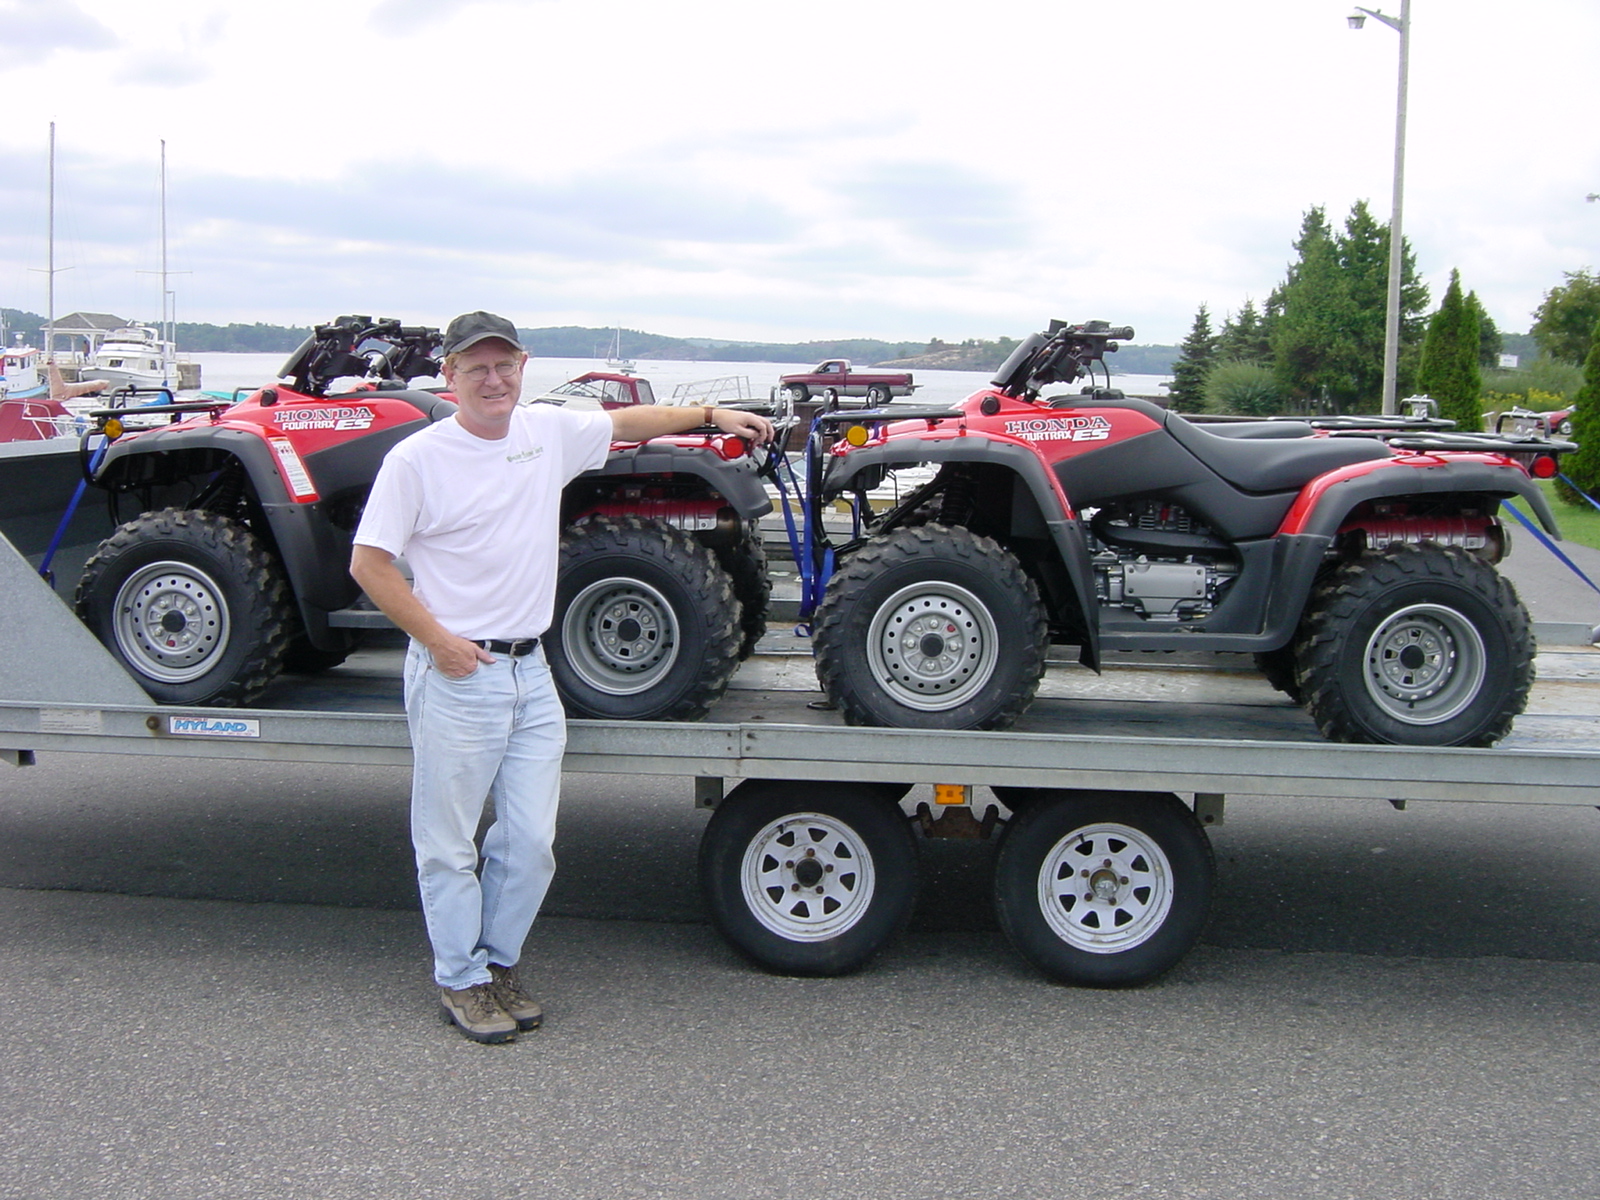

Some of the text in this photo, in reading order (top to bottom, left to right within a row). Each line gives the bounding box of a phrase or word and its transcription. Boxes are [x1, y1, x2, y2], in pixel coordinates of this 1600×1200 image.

[274, 406, 375, 423] HONDA
[282, 418, 374, 431] FOURTRAX ES
[1005, 416, 1112, 434] HONDA
[1072, 428, 1110, 441] ES
[175, 720, 247, 732] HYLAND
